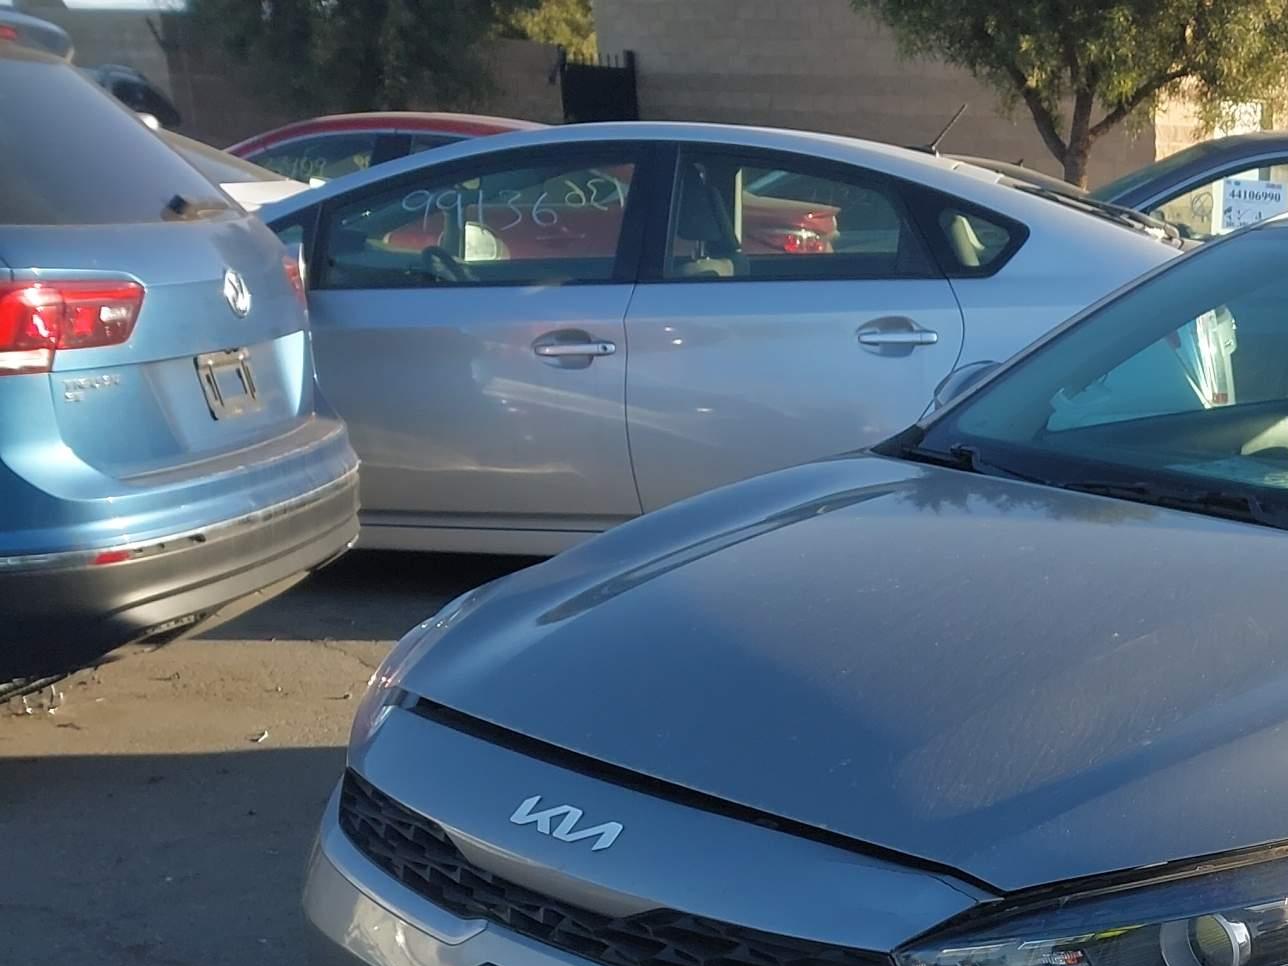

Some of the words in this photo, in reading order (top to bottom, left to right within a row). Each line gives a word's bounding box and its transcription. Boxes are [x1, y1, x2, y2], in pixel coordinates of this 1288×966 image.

[402, 188, 558, 231] 99136
[1230, 189, 1281, 202] 44106990
[510, 795, 624, 852] KIA
